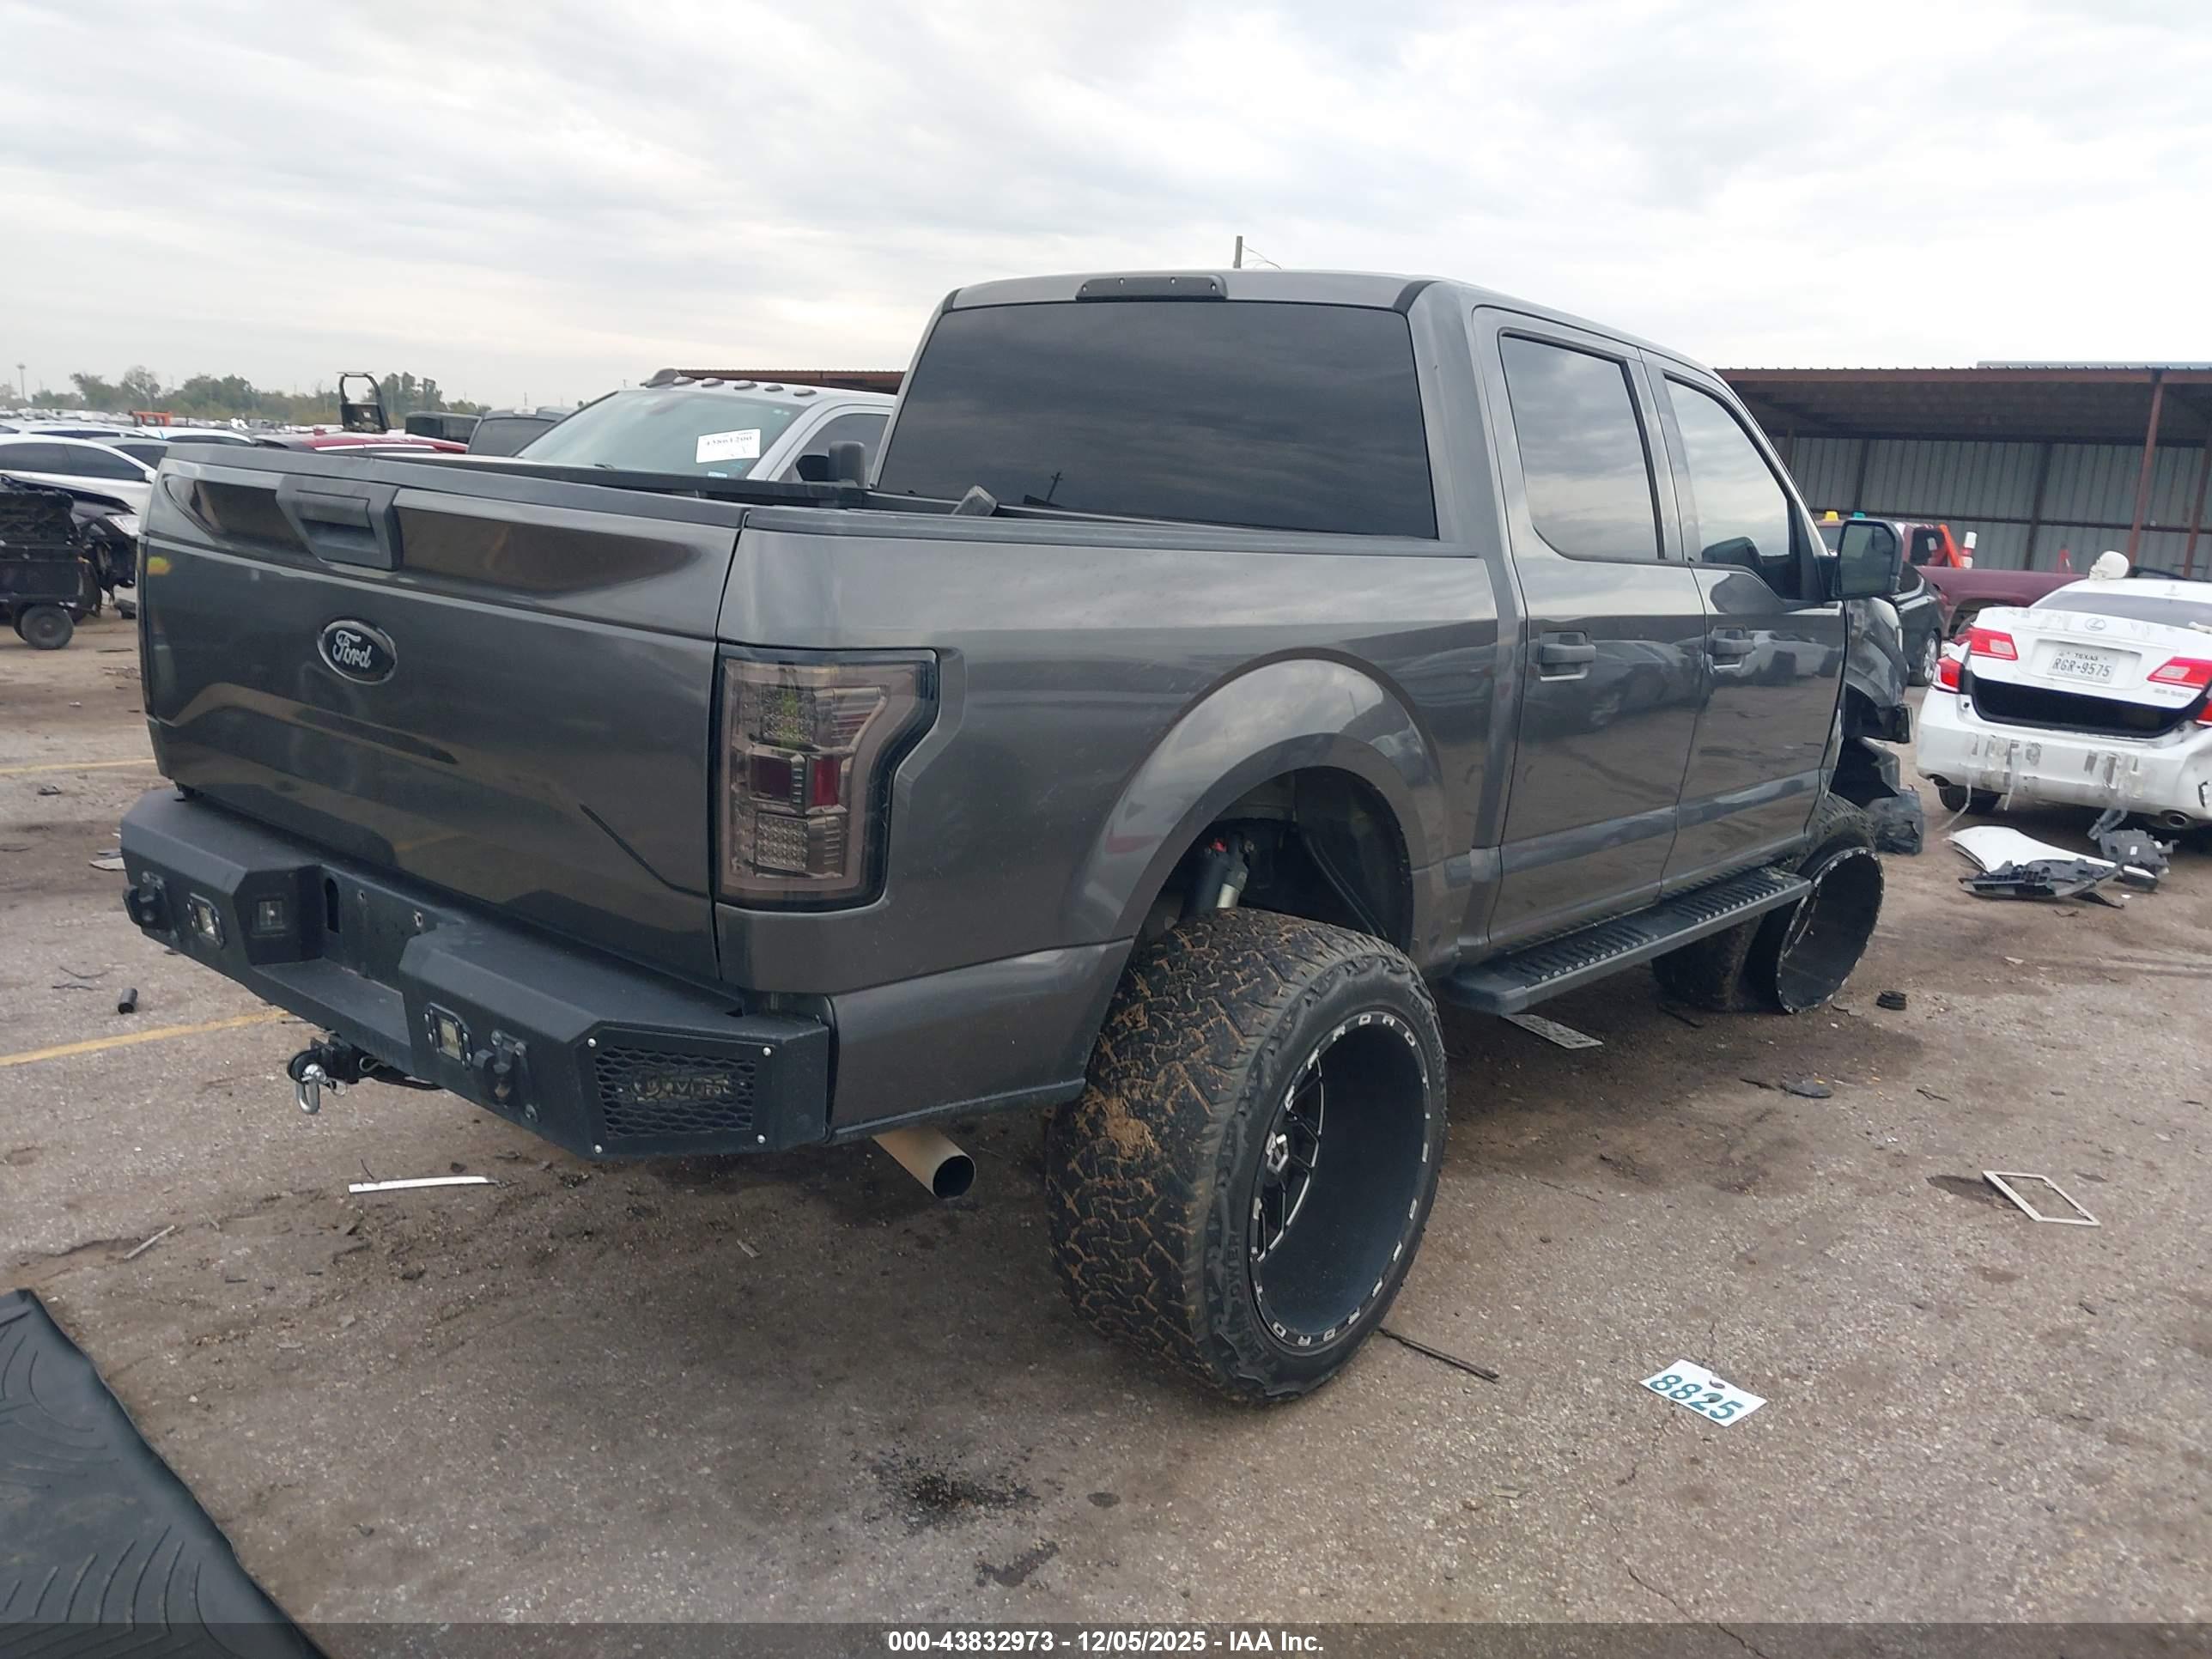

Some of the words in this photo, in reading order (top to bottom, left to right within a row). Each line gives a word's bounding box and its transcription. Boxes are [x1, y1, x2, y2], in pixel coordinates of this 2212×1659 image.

[332, 630, 372, 668] Ford
[2052, 658, 2112, 677] RGR-9575
[1650, 1375, 1745, 1419] 8825
